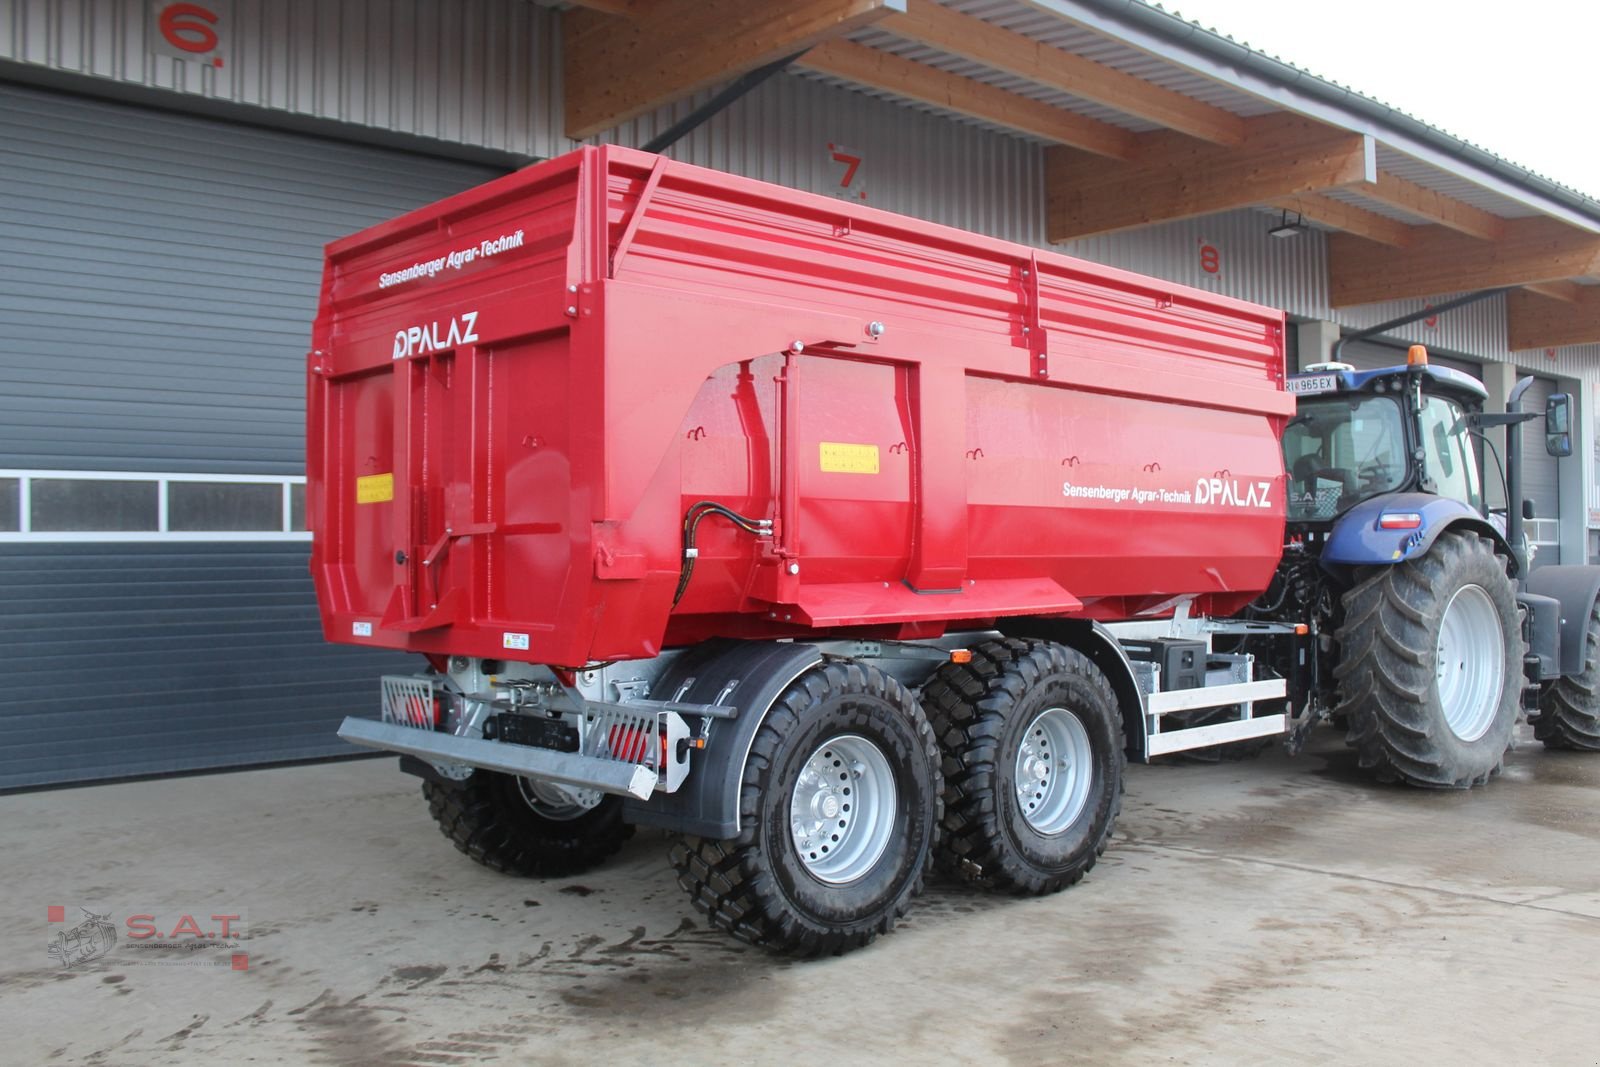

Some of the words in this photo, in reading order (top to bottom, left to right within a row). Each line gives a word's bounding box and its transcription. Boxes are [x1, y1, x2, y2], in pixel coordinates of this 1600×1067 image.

[159, 3, 218, 54] 6
[832, 152, 861, 188] 7
[379, 257, 446, 288] Sensenberger
[446, 229, 524, 270] Agrar-Technik
[1200, 245, 1219, 273] 8
[1063, 482, 1131, 503] Sensenberger
[1131, 487, 1192, 504] Agrar-Technik
